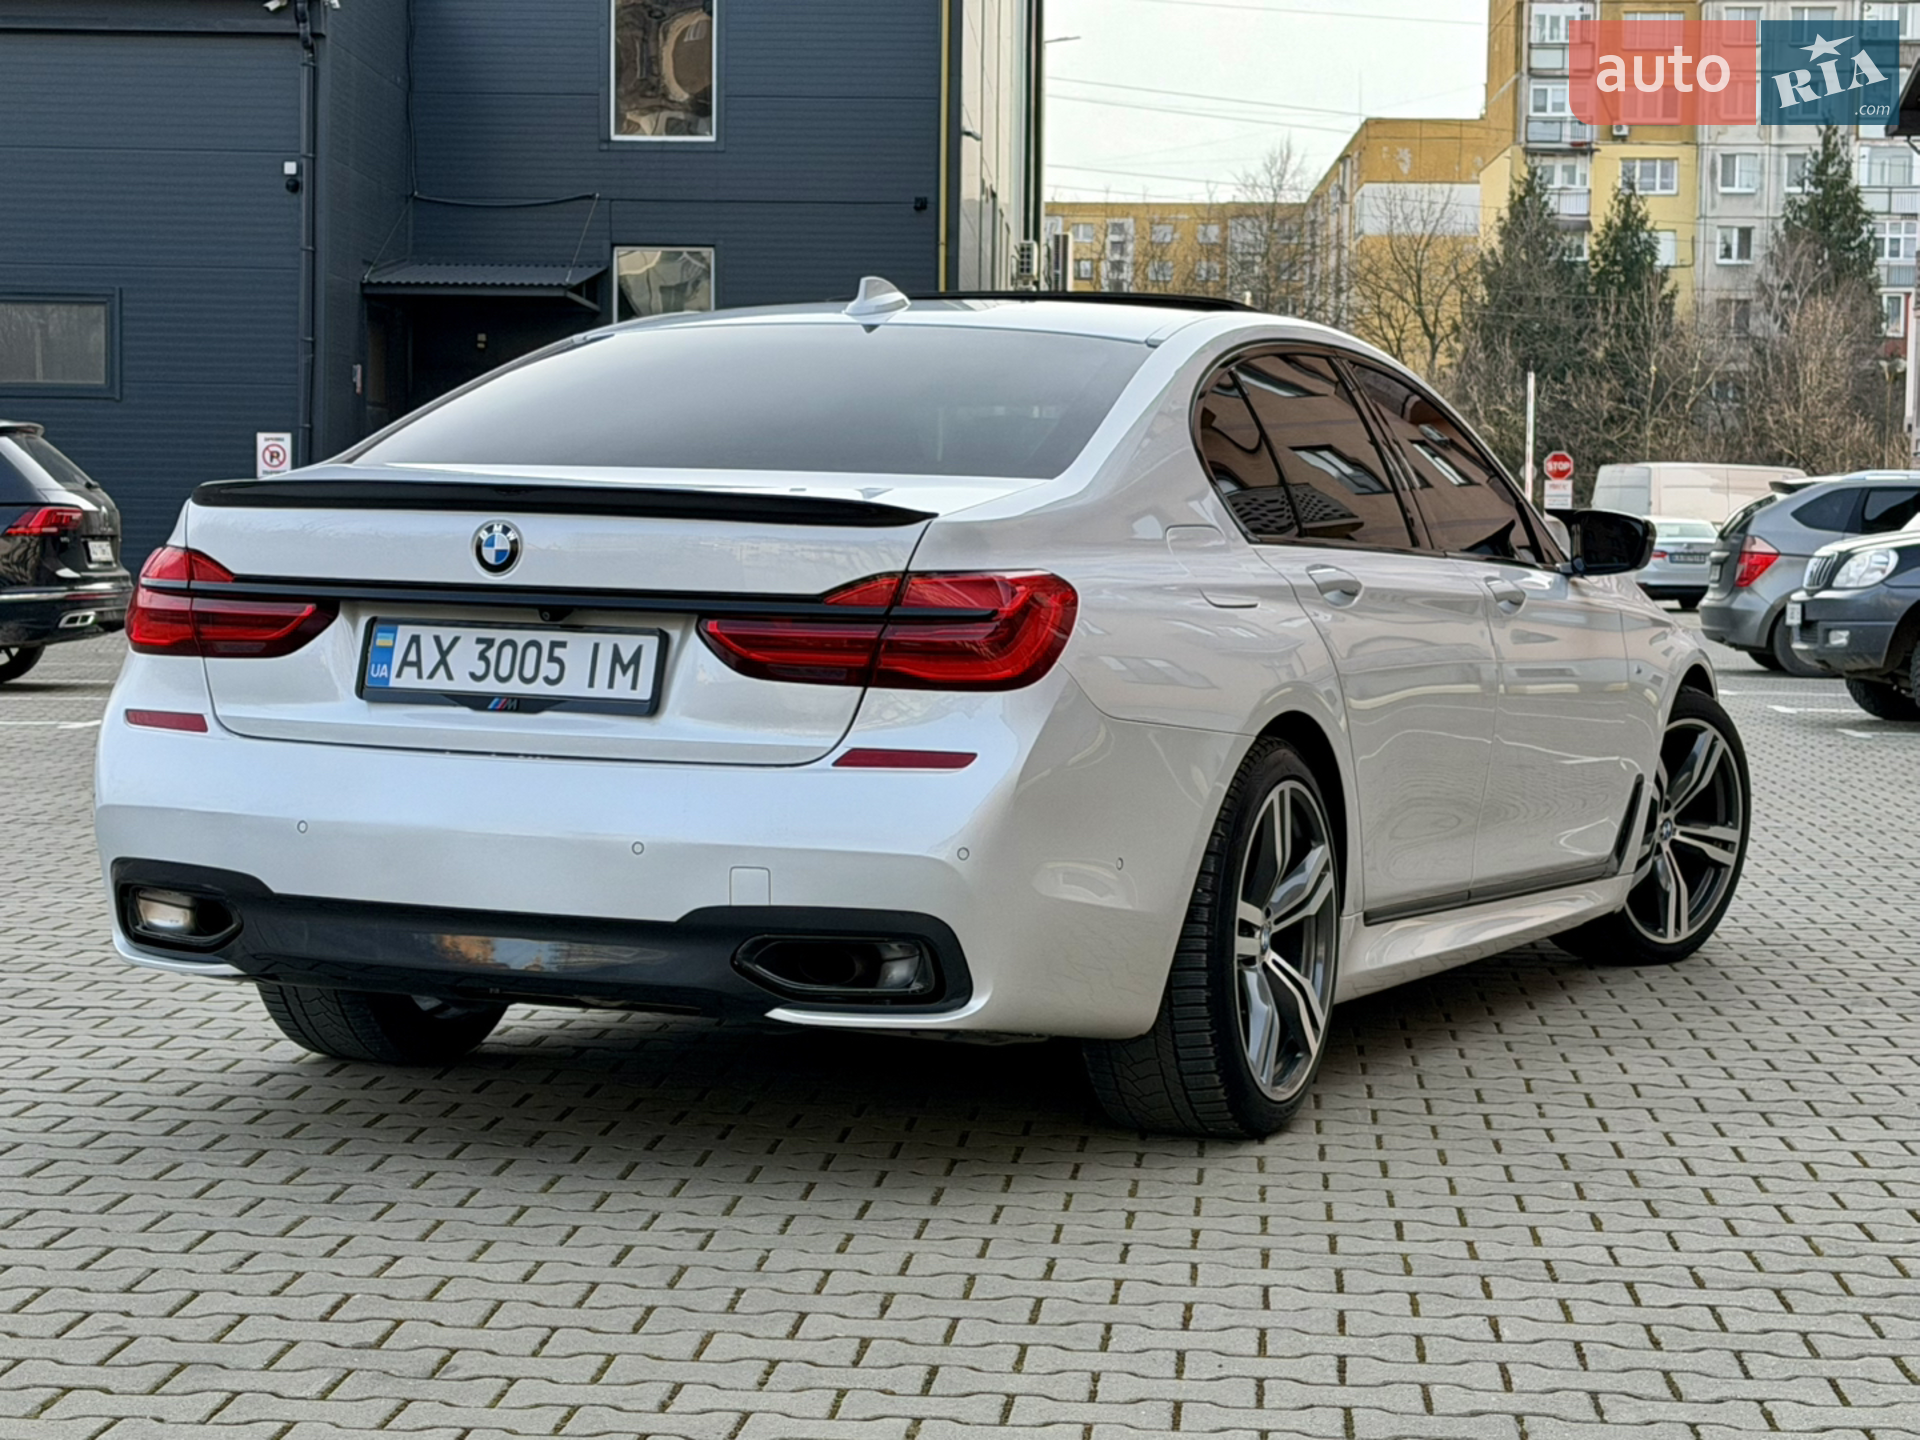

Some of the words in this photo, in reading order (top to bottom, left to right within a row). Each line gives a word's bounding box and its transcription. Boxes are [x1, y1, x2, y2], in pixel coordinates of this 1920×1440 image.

[1547, 461, 1570, 471] STOP
[479, 523, 518, 541] BMW
[395, 634, 461, 681] AX
[468, 637, 567, 686] 3005
[587, 642, 643, 691] IM
[370, 664, 389, 678] UA
